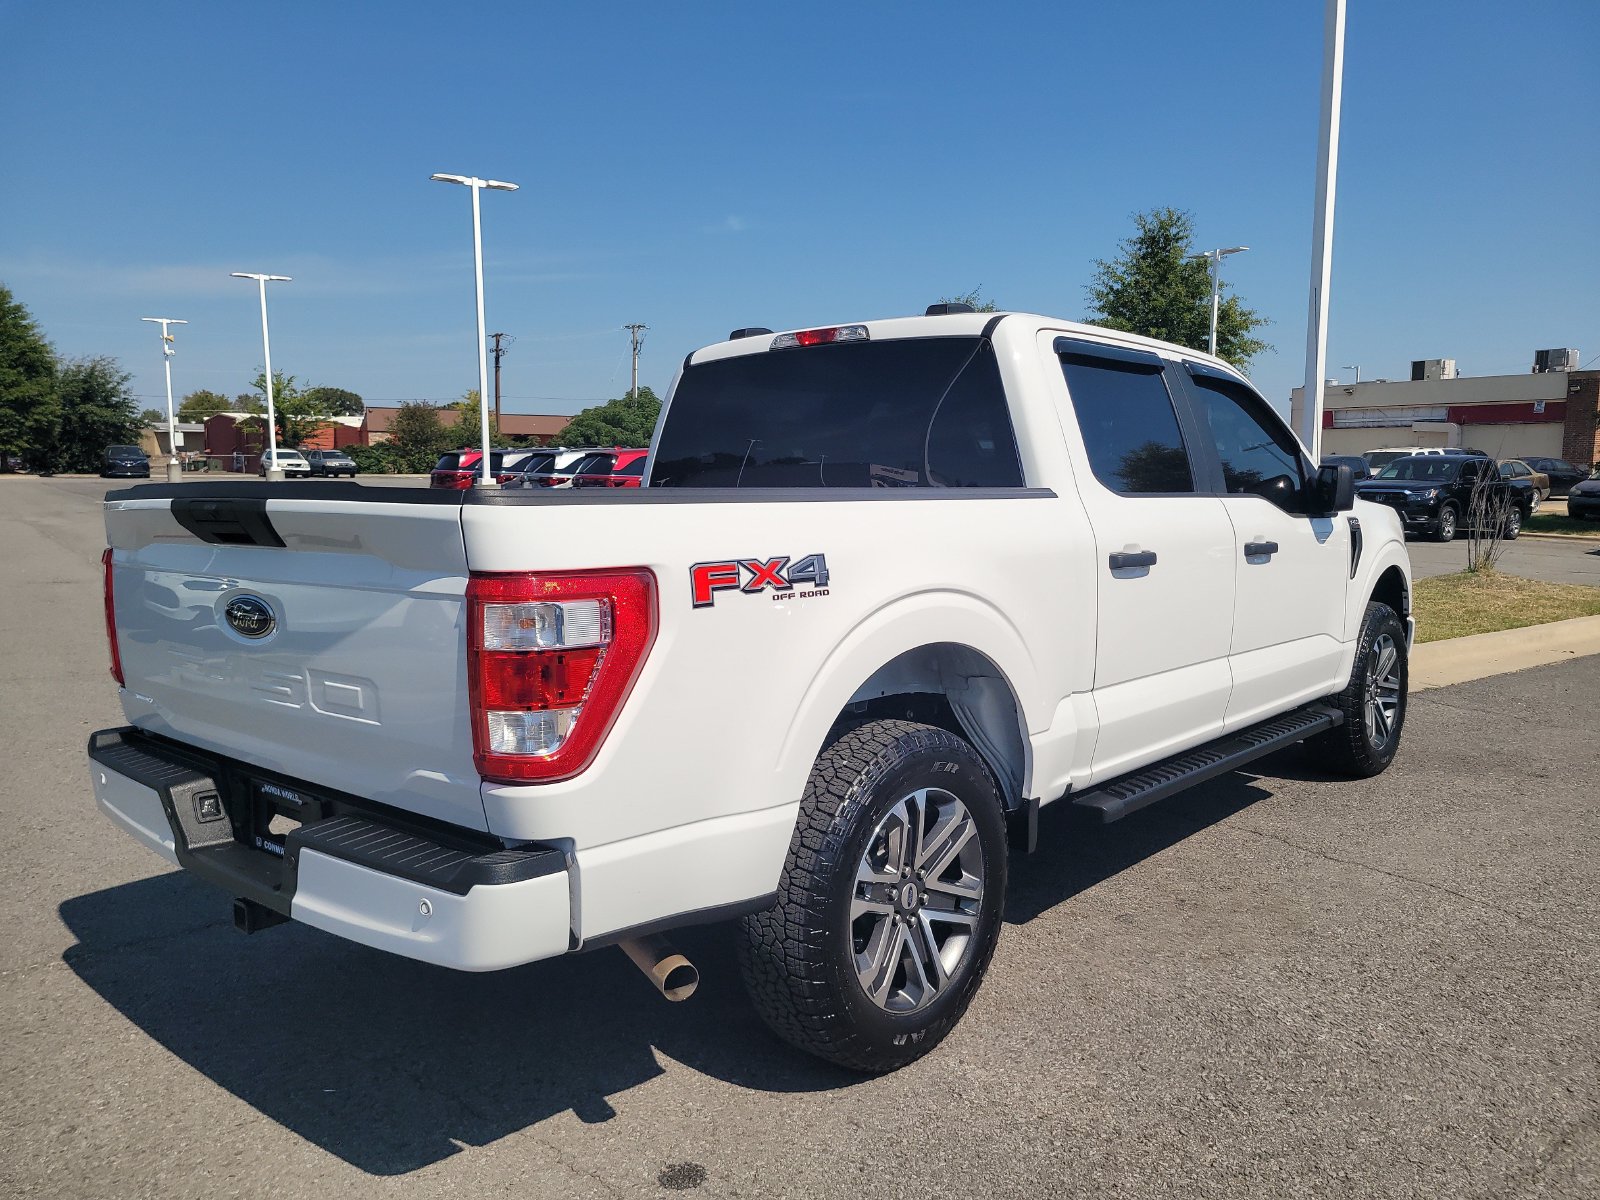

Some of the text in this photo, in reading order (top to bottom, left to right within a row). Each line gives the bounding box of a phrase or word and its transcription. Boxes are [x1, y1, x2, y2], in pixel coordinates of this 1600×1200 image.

[690, 553, 830, 609] FX4
[772, 589, 830, 601] OFF ROAD
[230, 603, 260, 629] Ford
[264, 840, 286, 855] CONWA
